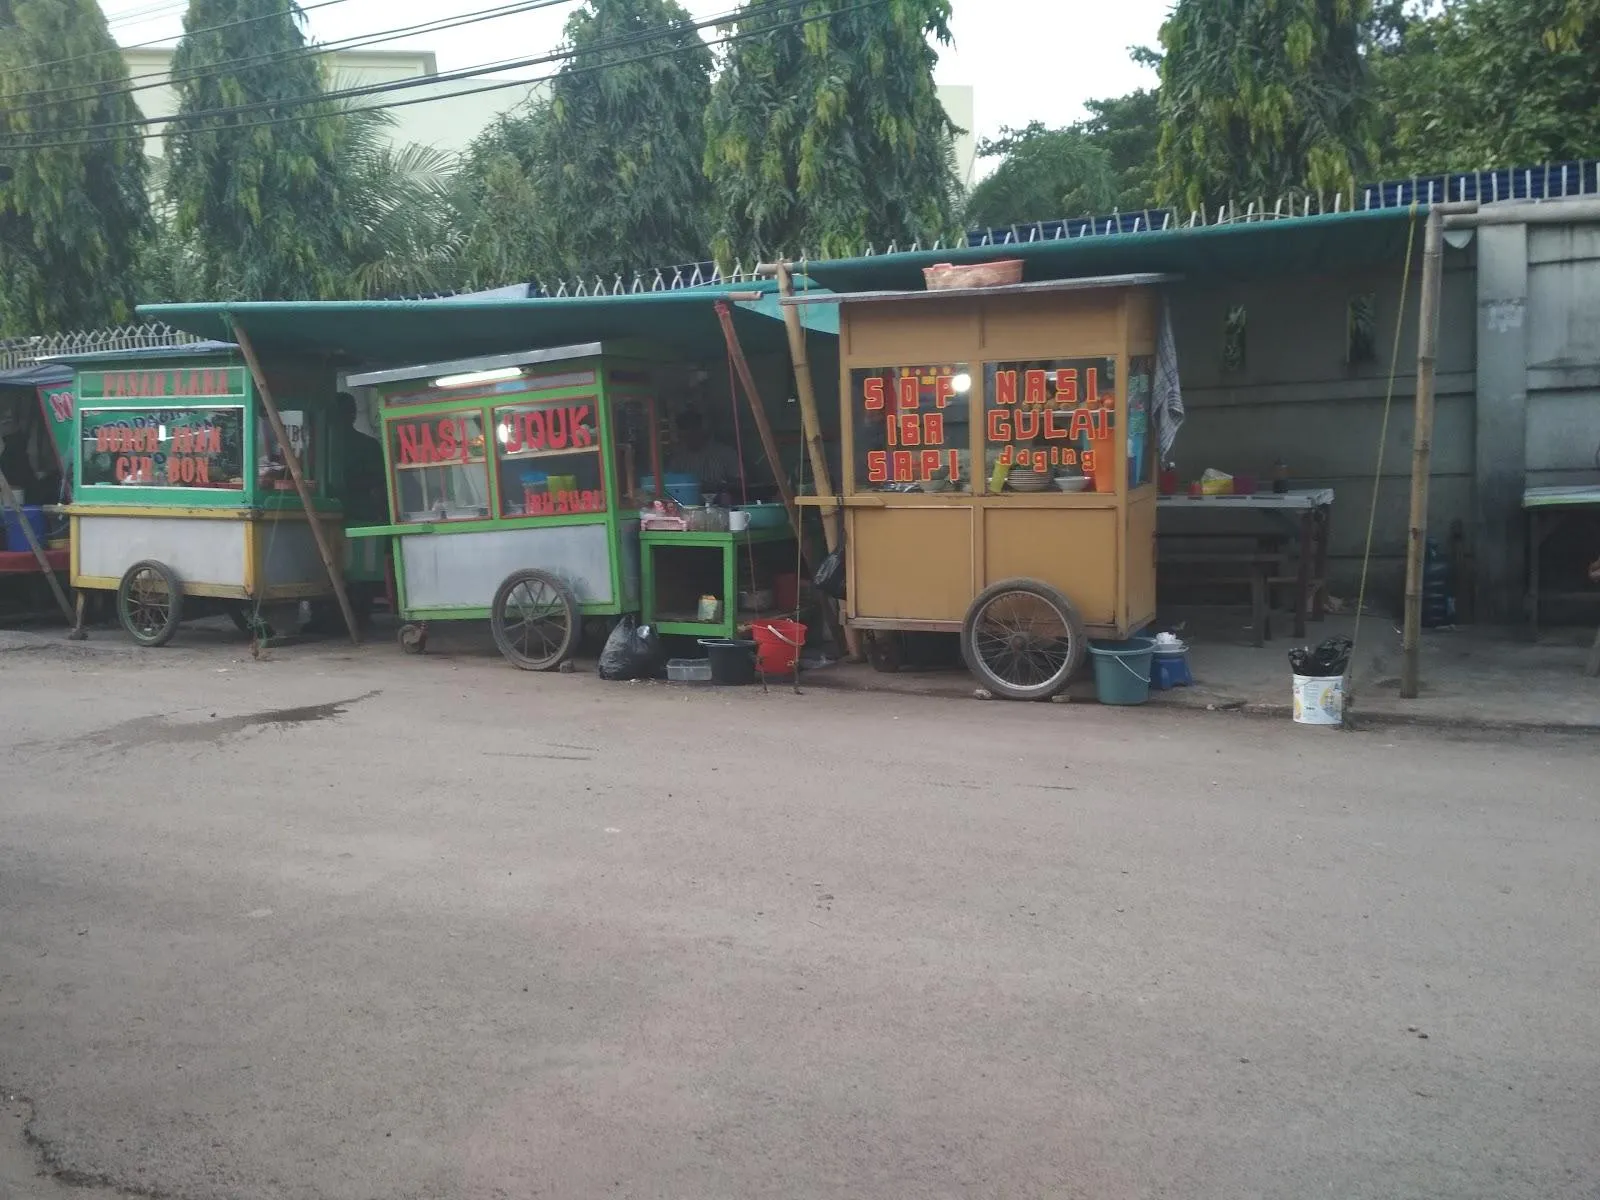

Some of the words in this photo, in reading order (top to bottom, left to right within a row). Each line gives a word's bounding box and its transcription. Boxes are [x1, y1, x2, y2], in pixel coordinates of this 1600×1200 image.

[863, 375, 958, 409] SOP
[995, 368, 1097, 404] NASI
[397, 416, 468, 464] NASI
[504, 405, 591, 453] UDUK
[988, 408, 1108, 441] GULAI
[868, 448, 959, 482] SAPI
[999, 445, 1096, 473] daging
